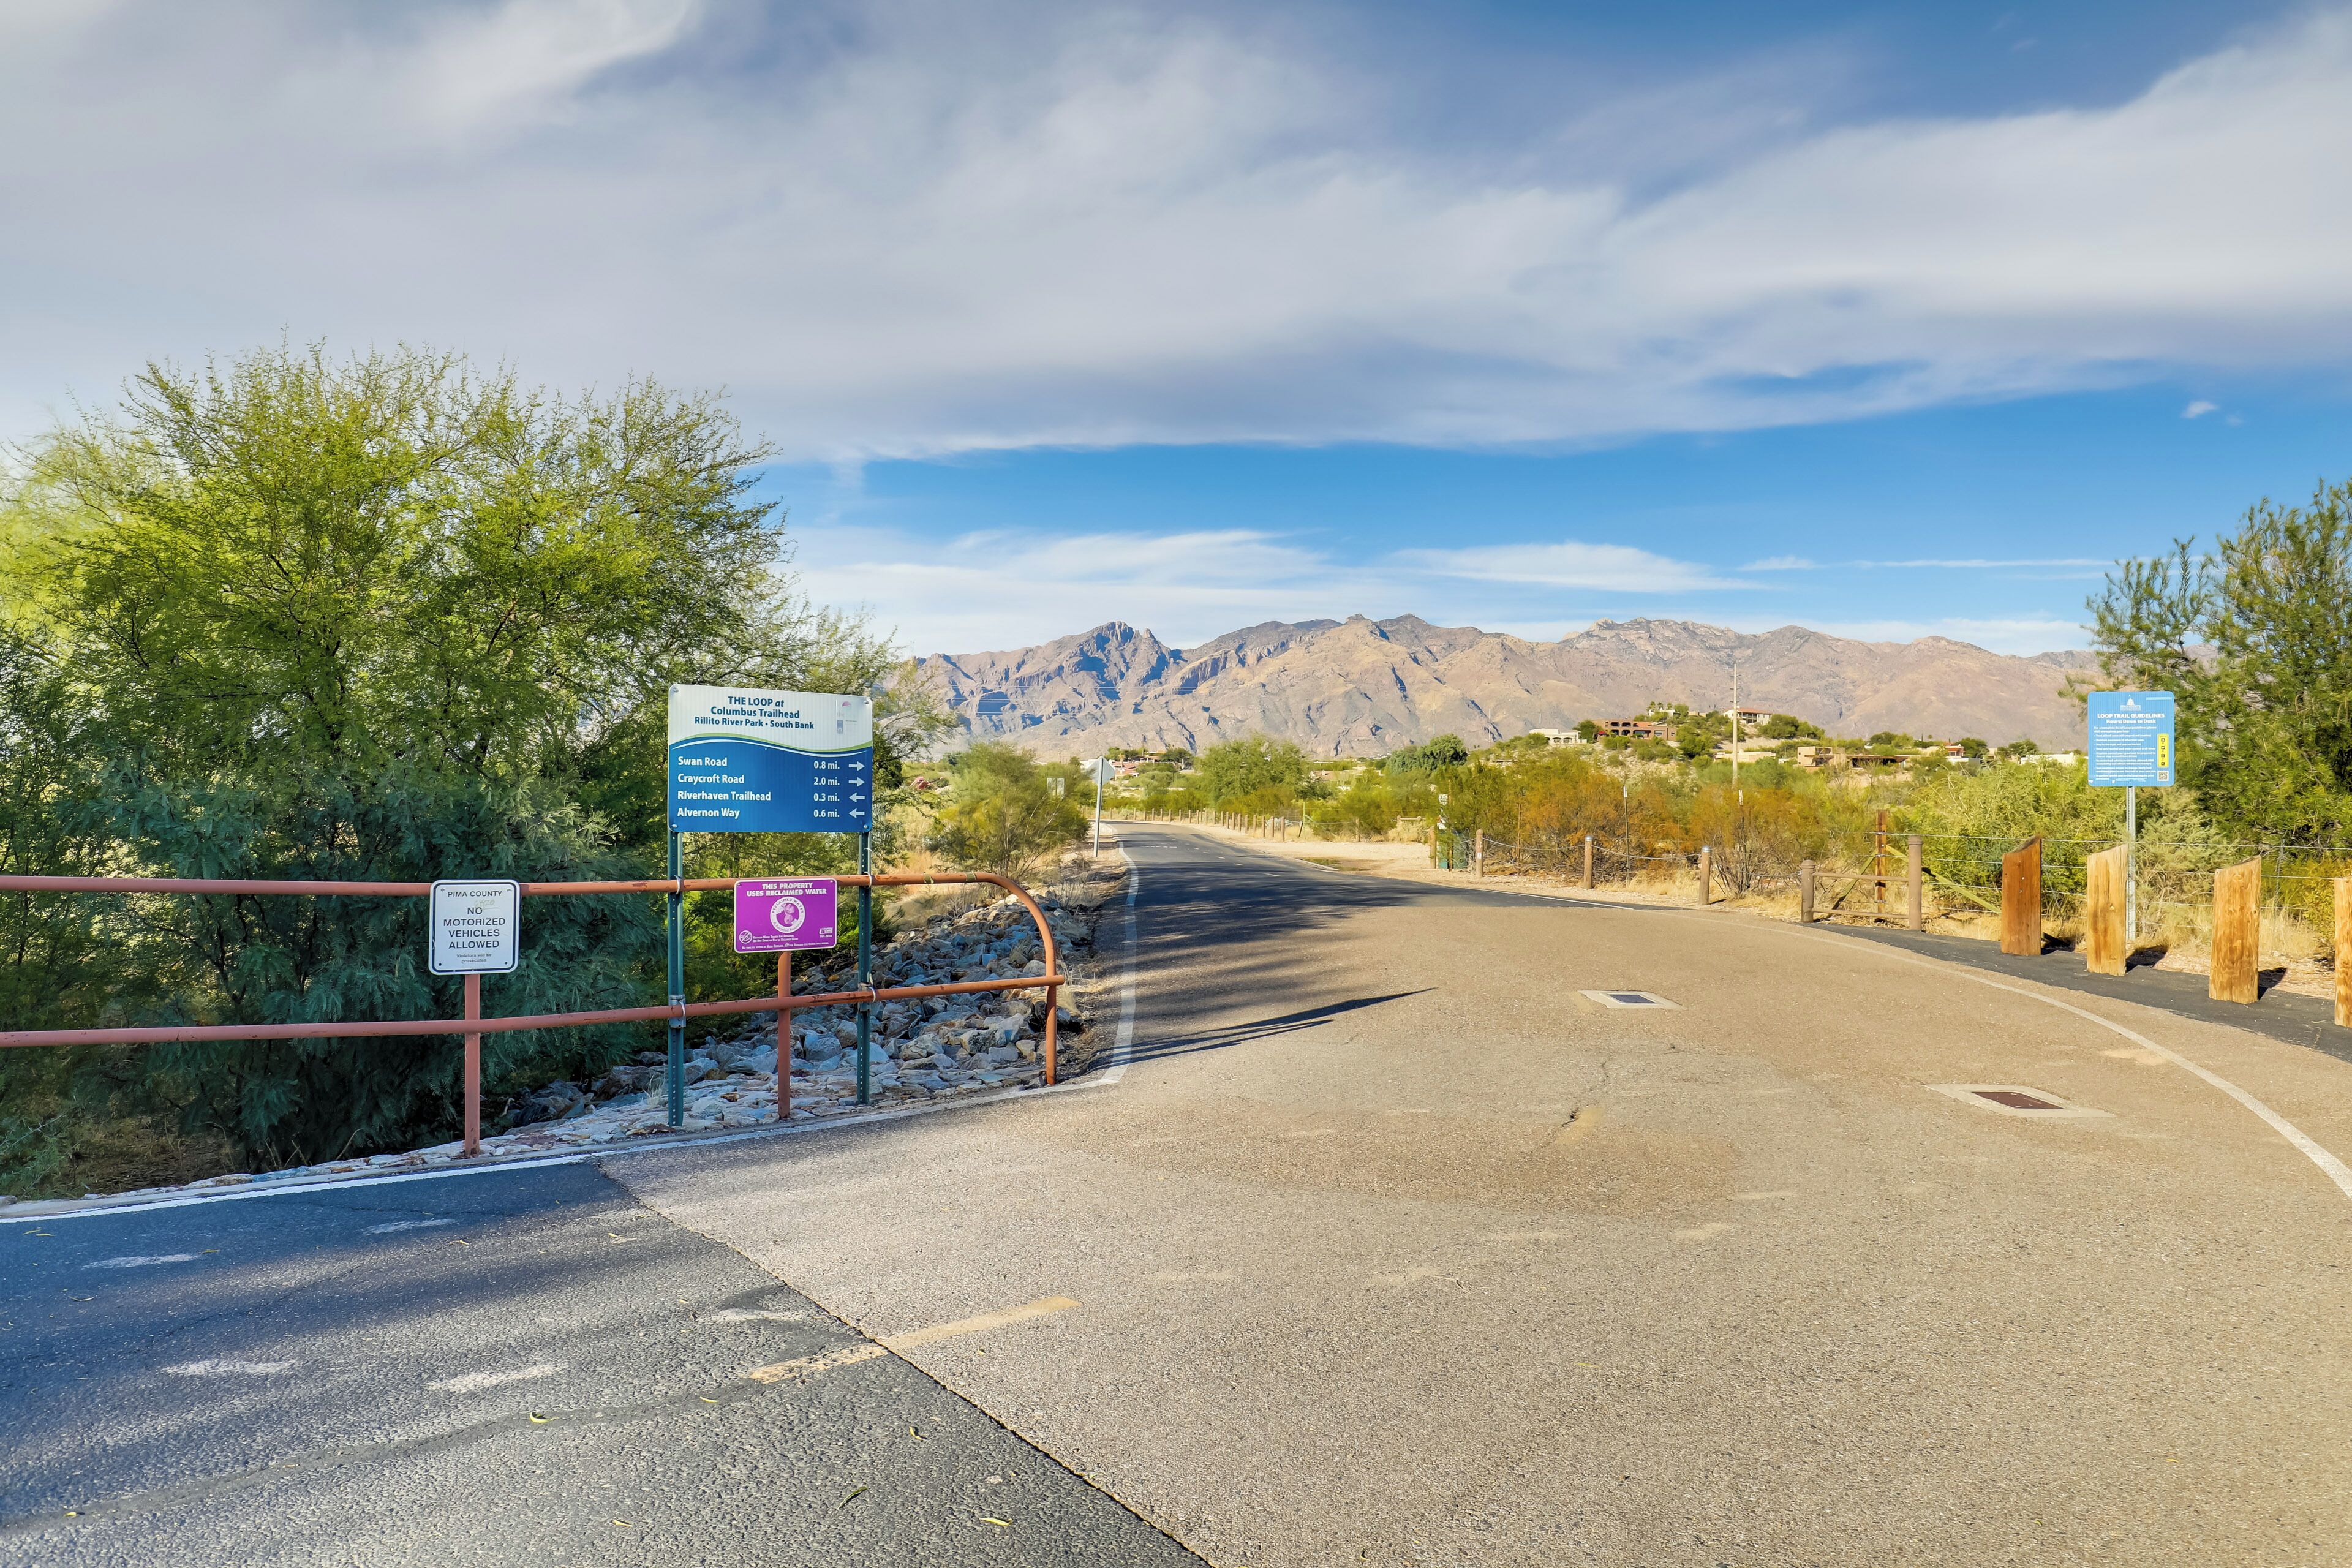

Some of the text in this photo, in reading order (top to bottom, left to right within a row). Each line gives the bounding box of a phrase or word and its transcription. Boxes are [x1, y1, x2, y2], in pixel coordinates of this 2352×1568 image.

[728, 696, 746, 706] THE
[748, 697, 773, 707] LOOP
[710, 706, 800, 718] Columbus Trailhead
[695, 717, 720, 725] Rillito
[722, 718, 743, 726] River
[745, 718, 764, 727] Park
[678, 756, 703, 766] Swan
[704, 757, 728, 766] Road
[827, 761, 840, 770] mi.
[677, 774, 720, 785] Craycroft
[722, 774, 744, 783] Road
[827, 777, 840, 786] mi.
[677, 791, 729, 801] Riverhaven
[731, 791, 771, 801] Trailhead
[827, 793, 840, 802] mi.
[677, 807, 719, 818] Alvernon
[722, 808, 740, 820] Way
[827, 809, 840, 818] mi.
[448, 940, 499, 949] ALLOWED
